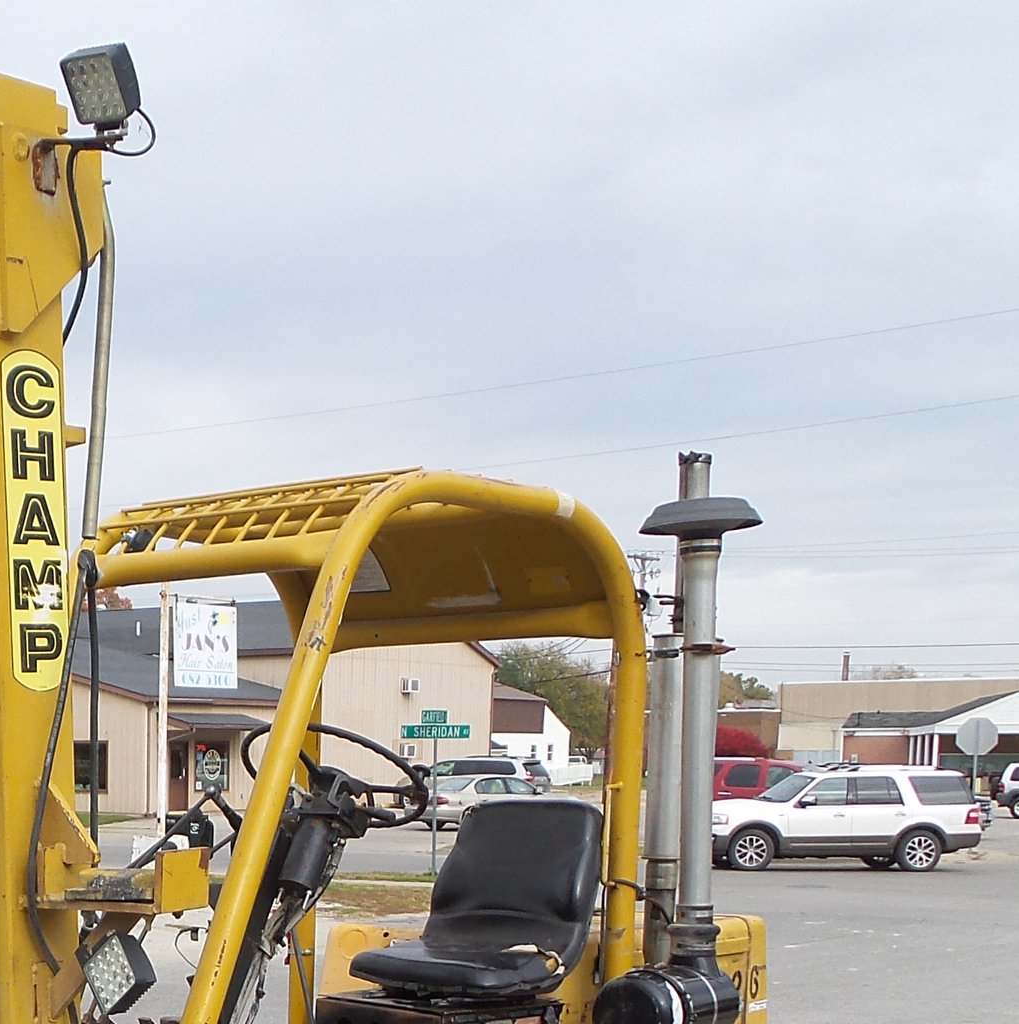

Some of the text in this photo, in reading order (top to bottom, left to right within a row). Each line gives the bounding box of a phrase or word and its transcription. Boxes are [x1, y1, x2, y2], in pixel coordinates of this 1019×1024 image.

[5, 364, 63, 673] CHAMP
[182, 632, 230, 653] JAN'S
[401, 727, 407, 737] N
[413, 727, 460, 737] SHERIDAN
